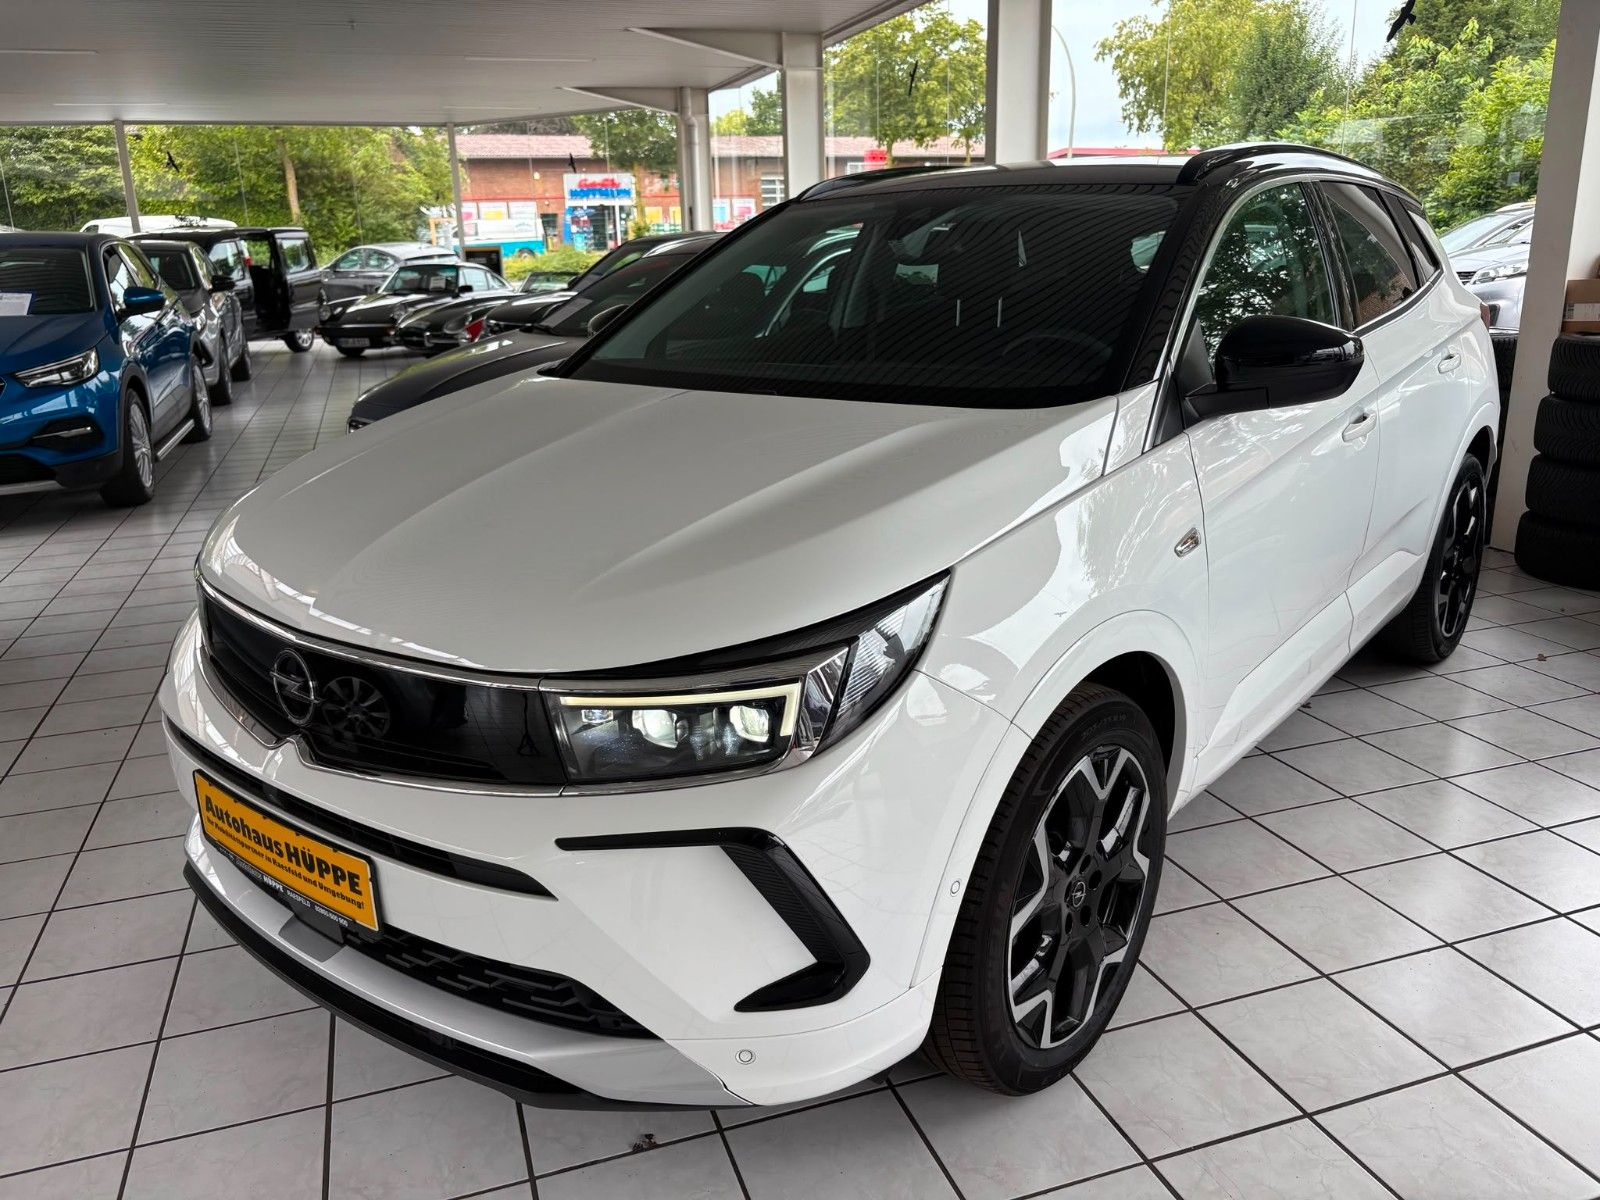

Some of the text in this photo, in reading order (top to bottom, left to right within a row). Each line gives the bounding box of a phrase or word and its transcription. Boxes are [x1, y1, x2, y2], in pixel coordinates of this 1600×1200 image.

[205, 794, 363, 897] Autohaus HÜPPE
[265, 854, 273, 864] in
[272, 858, 303, 880] Raesfeld
[302, 875, 318, 889] und
[318, 880, 365, 910] Umgebung!
